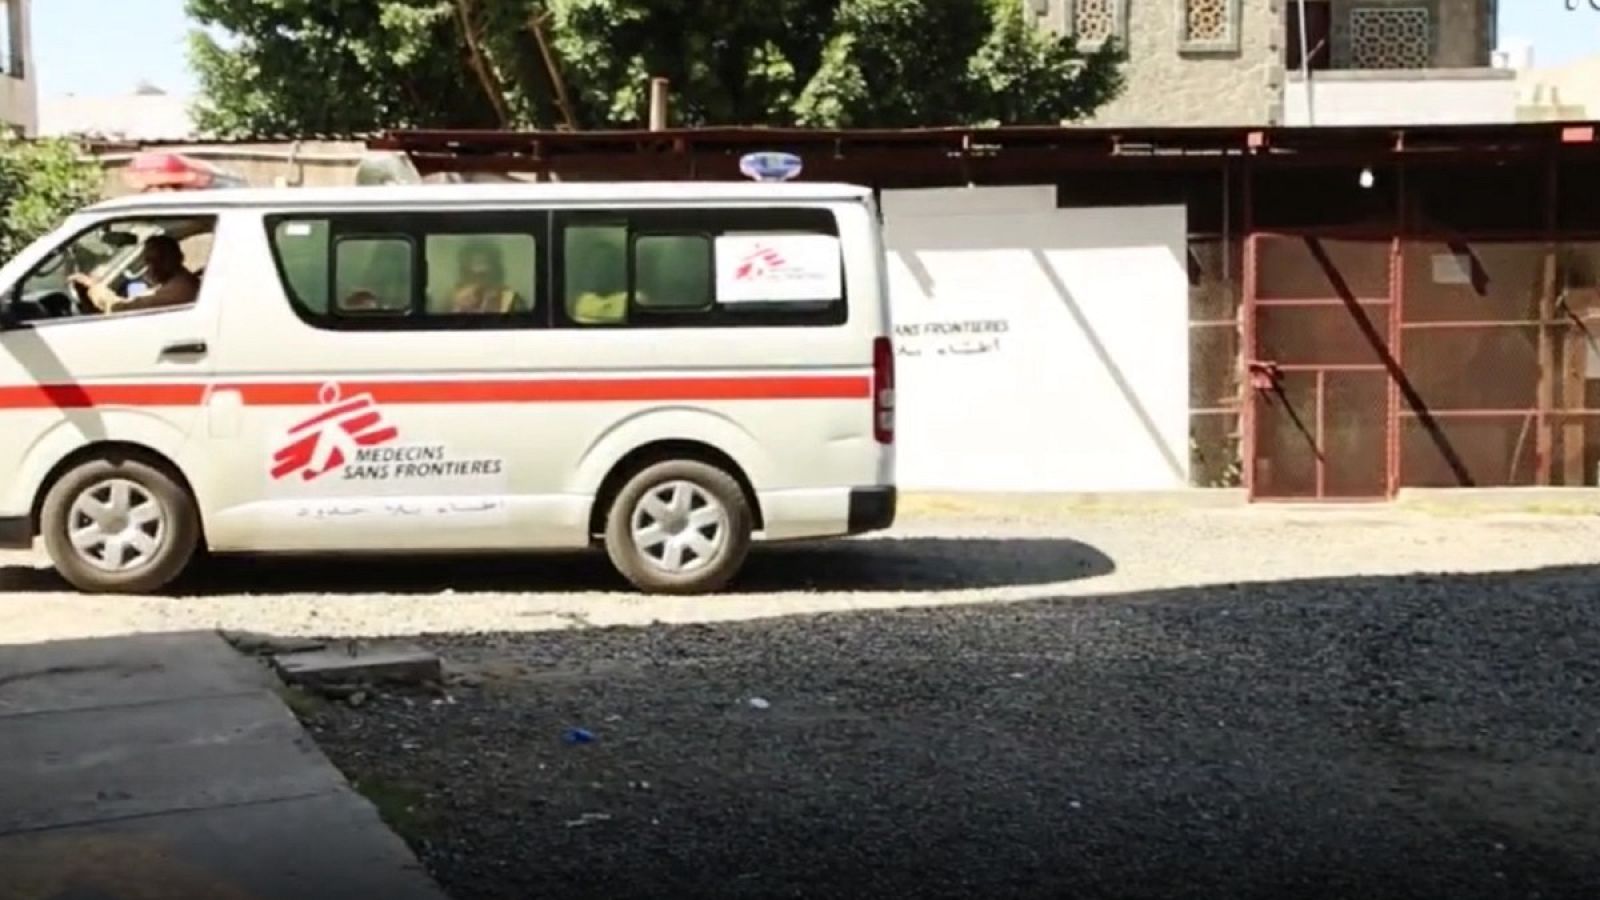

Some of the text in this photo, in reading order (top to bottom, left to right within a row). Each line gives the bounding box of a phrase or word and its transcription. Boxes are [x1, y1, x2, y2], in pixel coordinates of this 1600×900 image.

[355, 445, 445, 462] MEDECINS
[343, 459, 502, 480] SANS FRONTIERES
